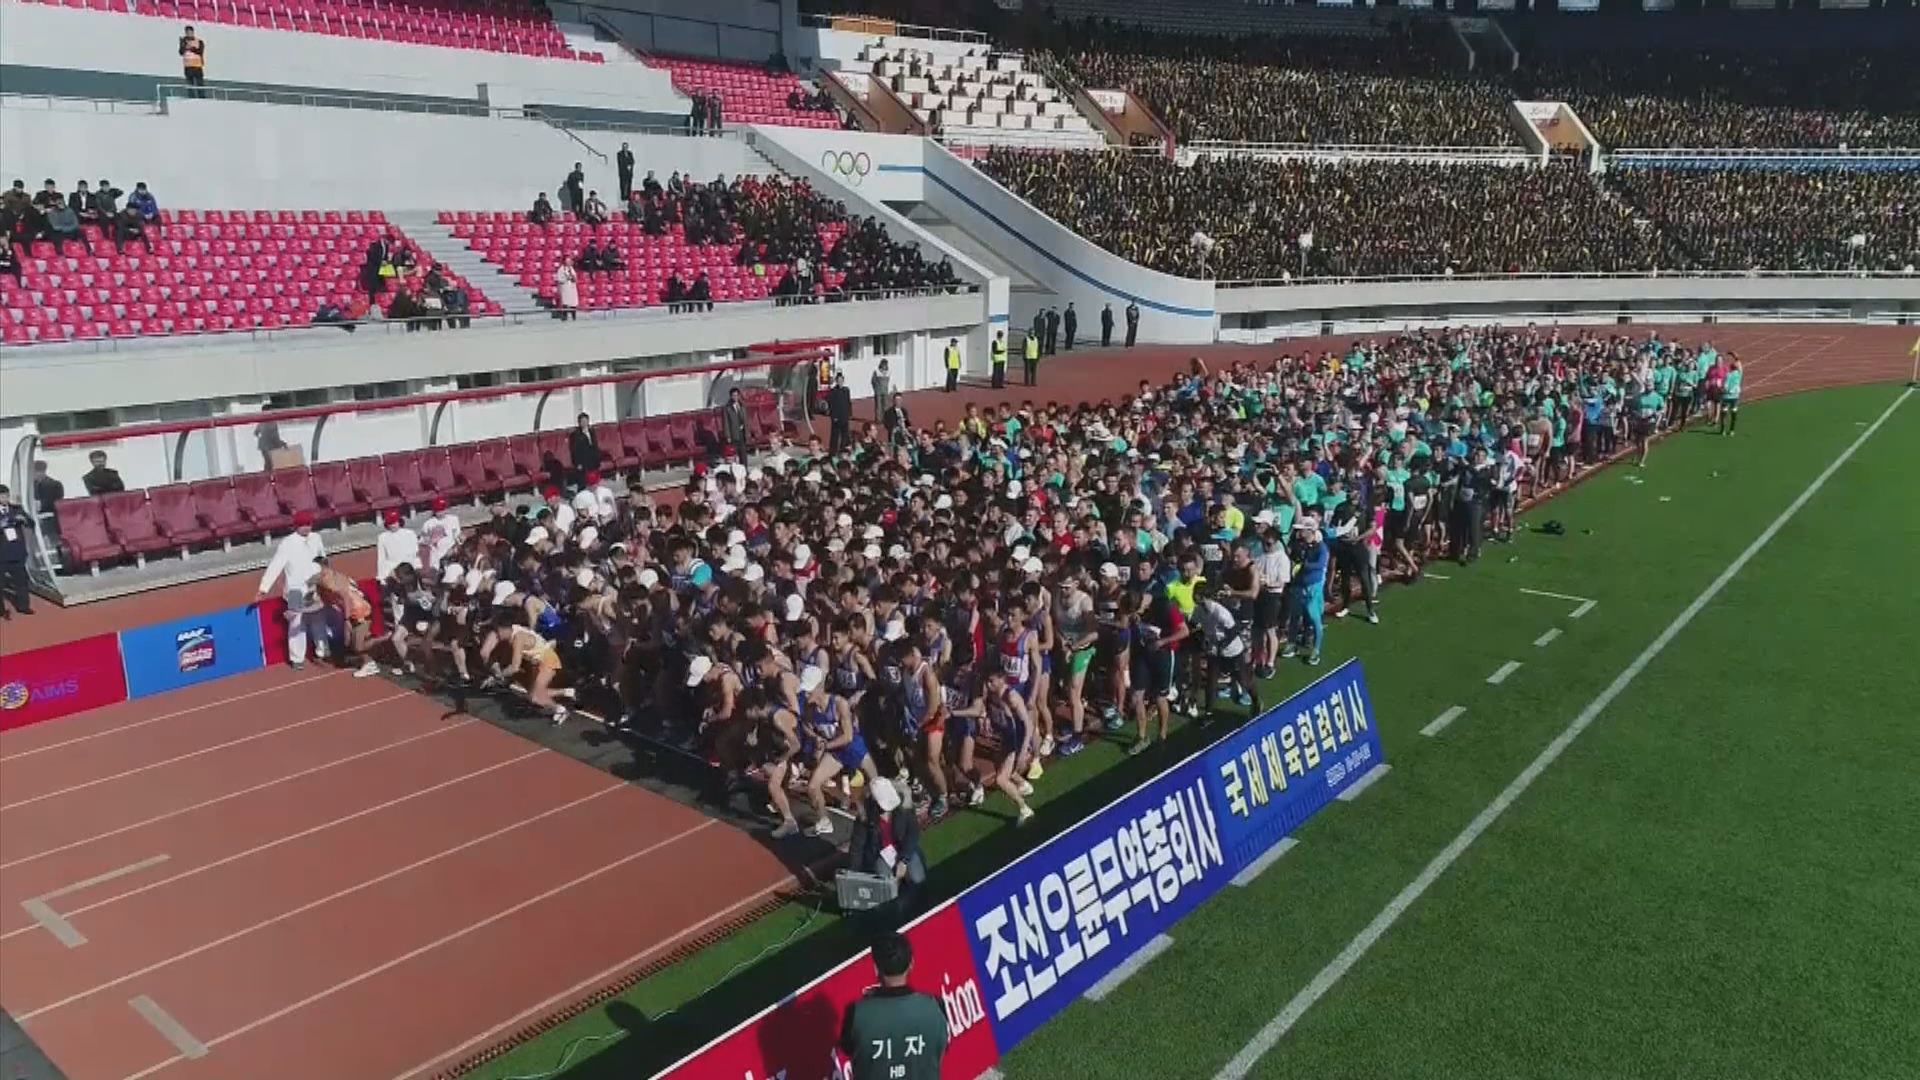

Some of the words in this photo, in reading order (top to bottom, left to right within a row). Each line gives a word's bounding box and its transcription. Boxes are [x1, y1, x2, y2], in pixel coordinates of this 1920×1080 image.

[31, 680, 79, 701] AIMS
[1220, 680, 1368, 817] 국제체육협력회사
[976, 777, 1223, 1021] 조선오륜무역총회사
[941, 972, 985, 1043] tion
